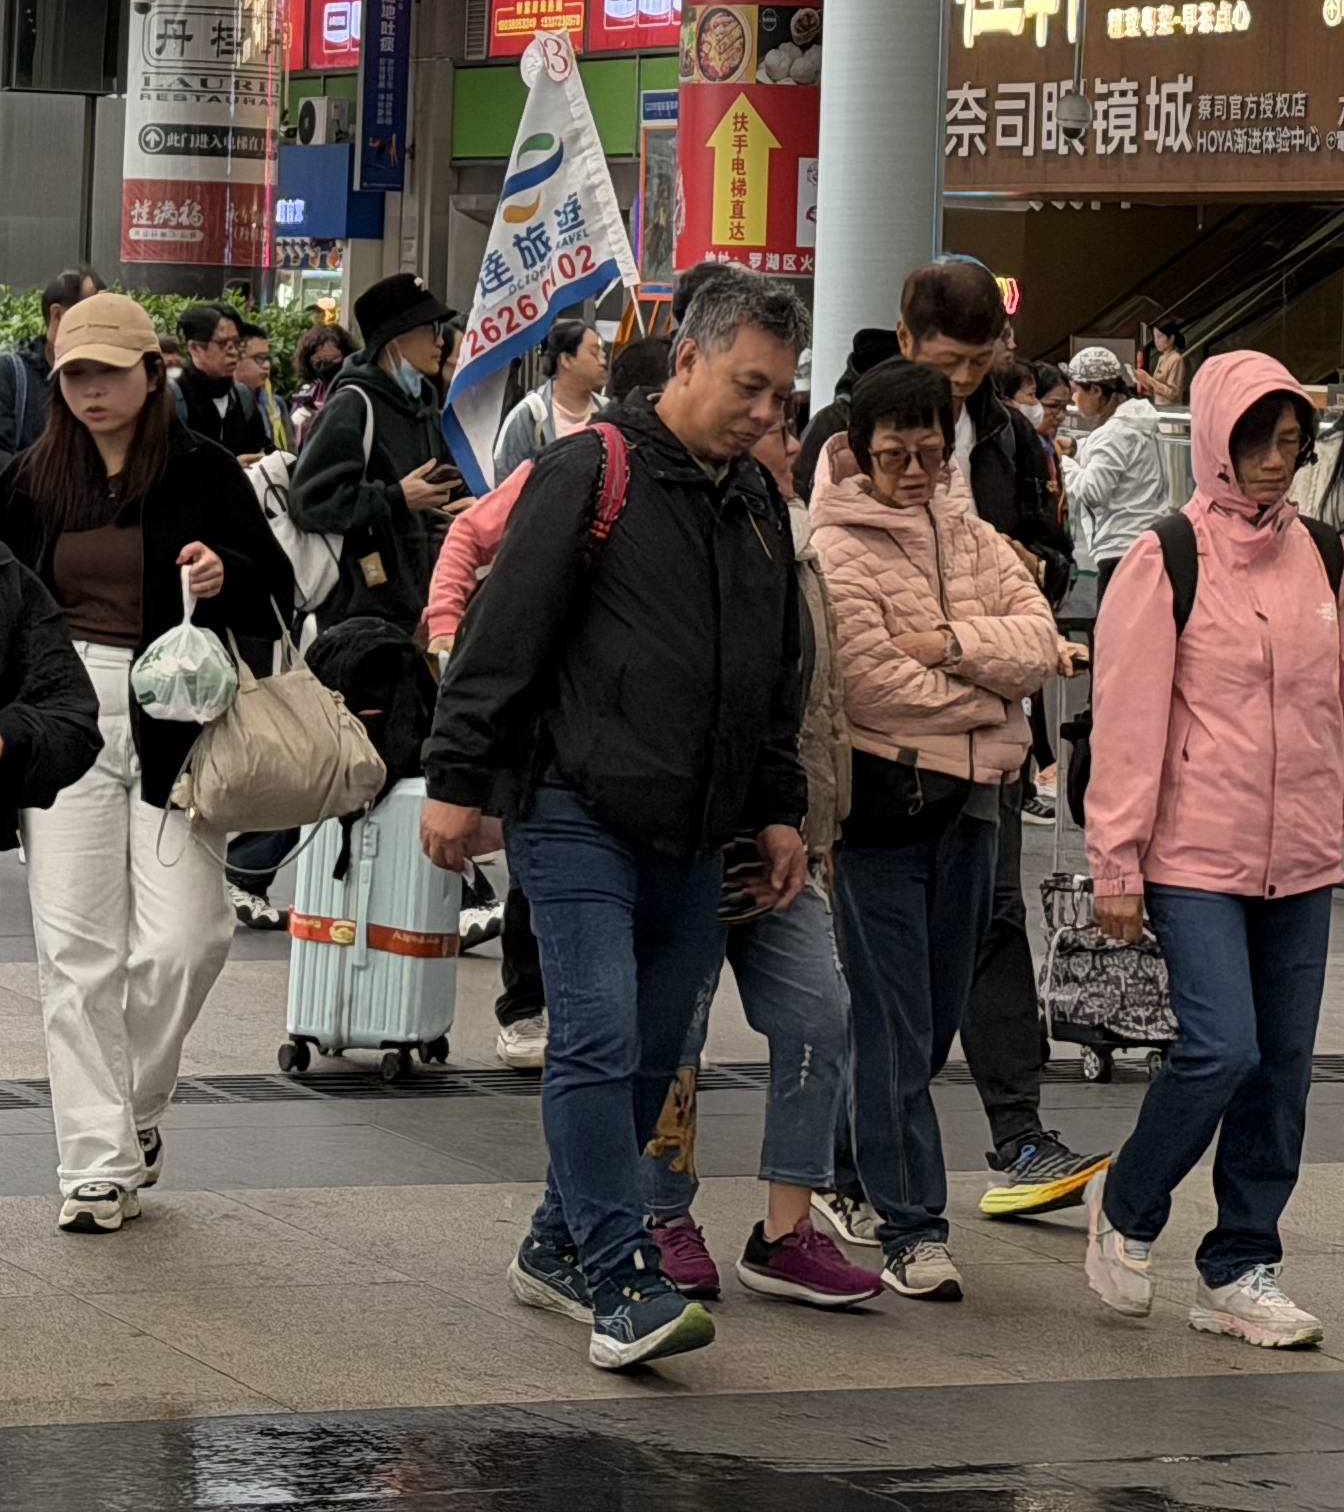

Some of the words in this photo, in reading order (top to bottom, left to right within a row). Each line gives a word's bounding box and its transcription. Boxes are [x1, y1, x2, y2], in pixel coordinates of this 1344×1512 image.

[1198, 91, 1306, 121] 蔡司官方授权店
[1197, 126, 1321, 154] HOYA渐进体验中心
[729, 111, 749, 241] 扶手电梯直达
